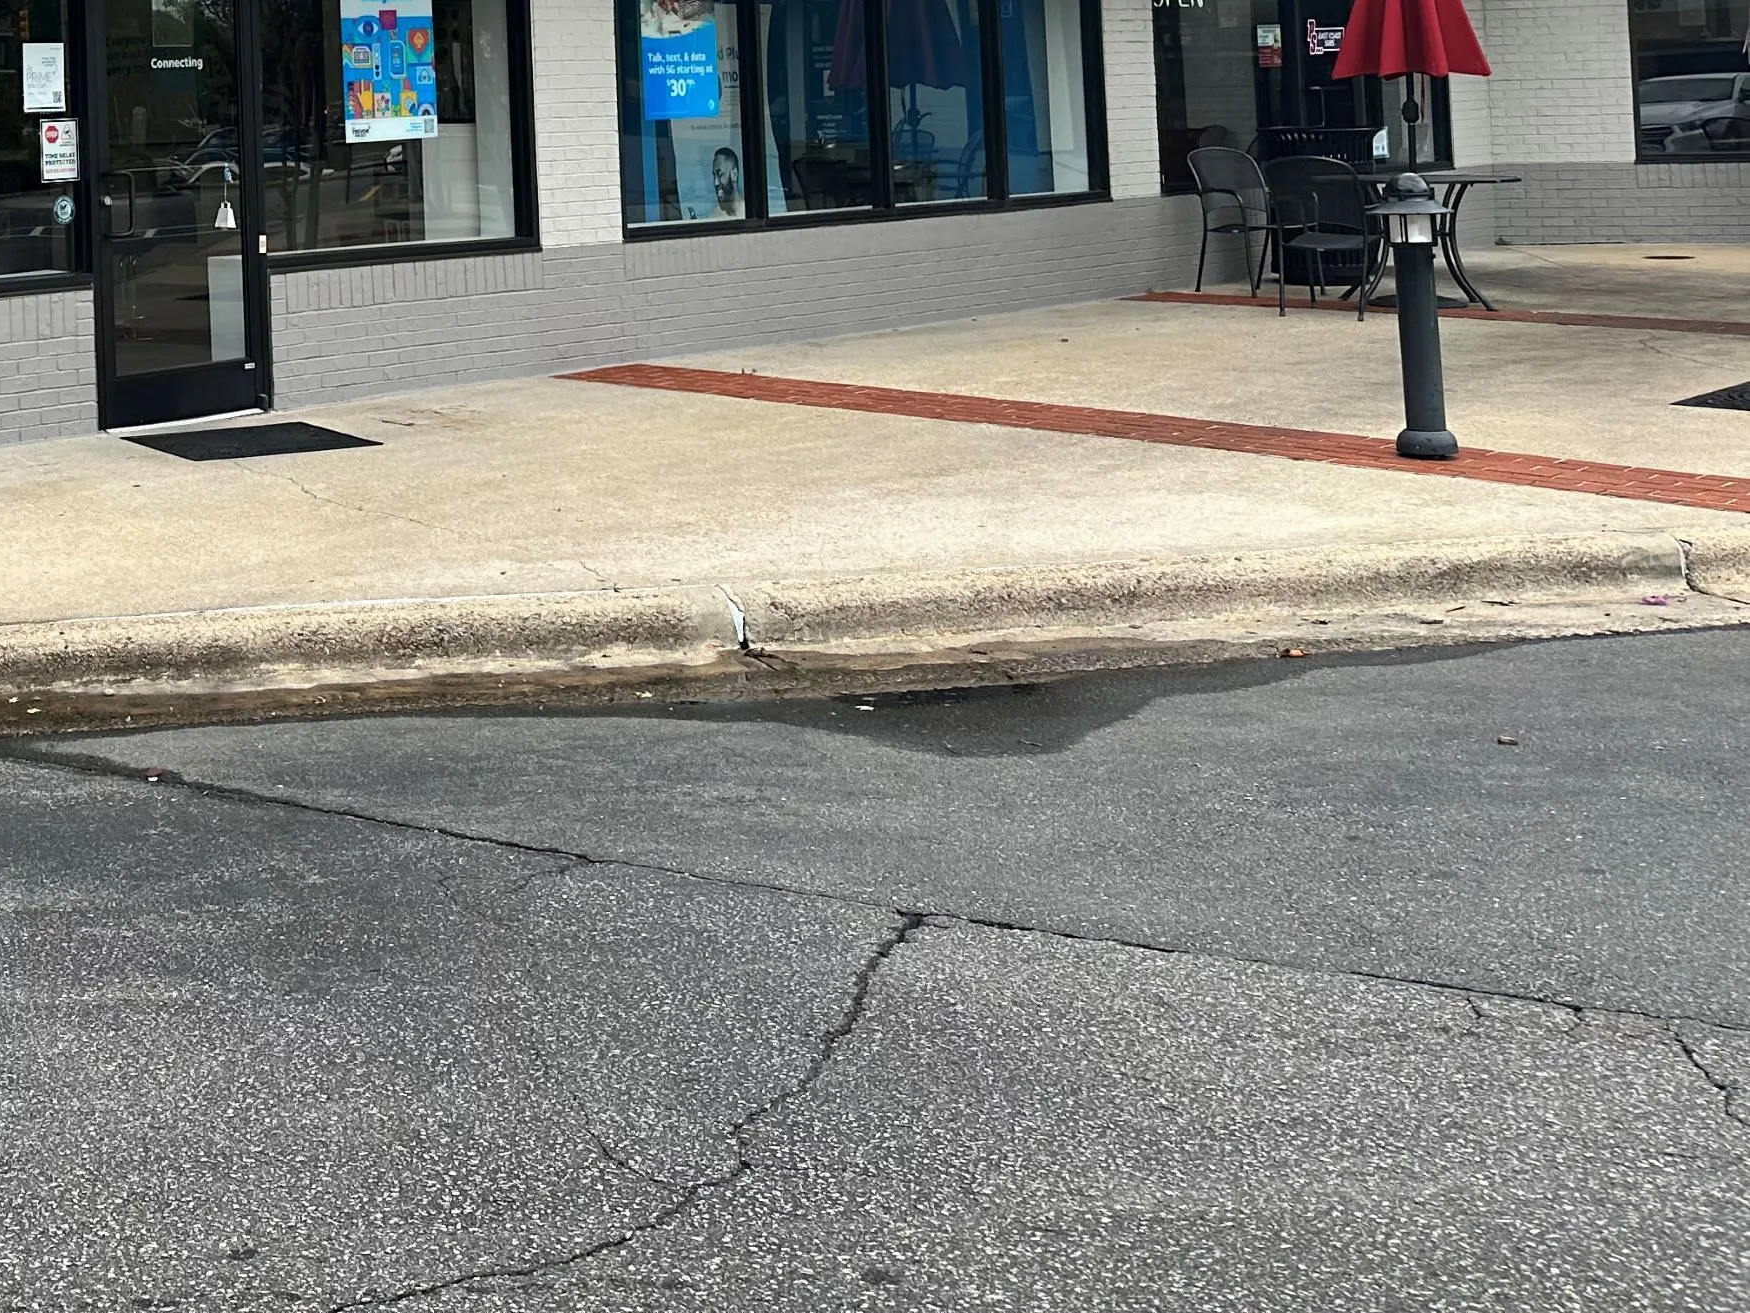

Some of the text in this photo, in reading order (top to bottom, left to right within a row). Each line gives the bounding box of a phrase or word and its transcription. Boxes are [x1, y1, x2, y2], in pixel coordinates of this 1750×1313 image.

[150, 56, 204, 70] Connecting
[647, 51, 665, 63] Talk,
[665, 53, 683, 63] text,
[690, 51, 706, 62] data
[648, 65, 665, 75] with
[676, 64, 705, 76] starting
[705, 64, 714, 73] at
